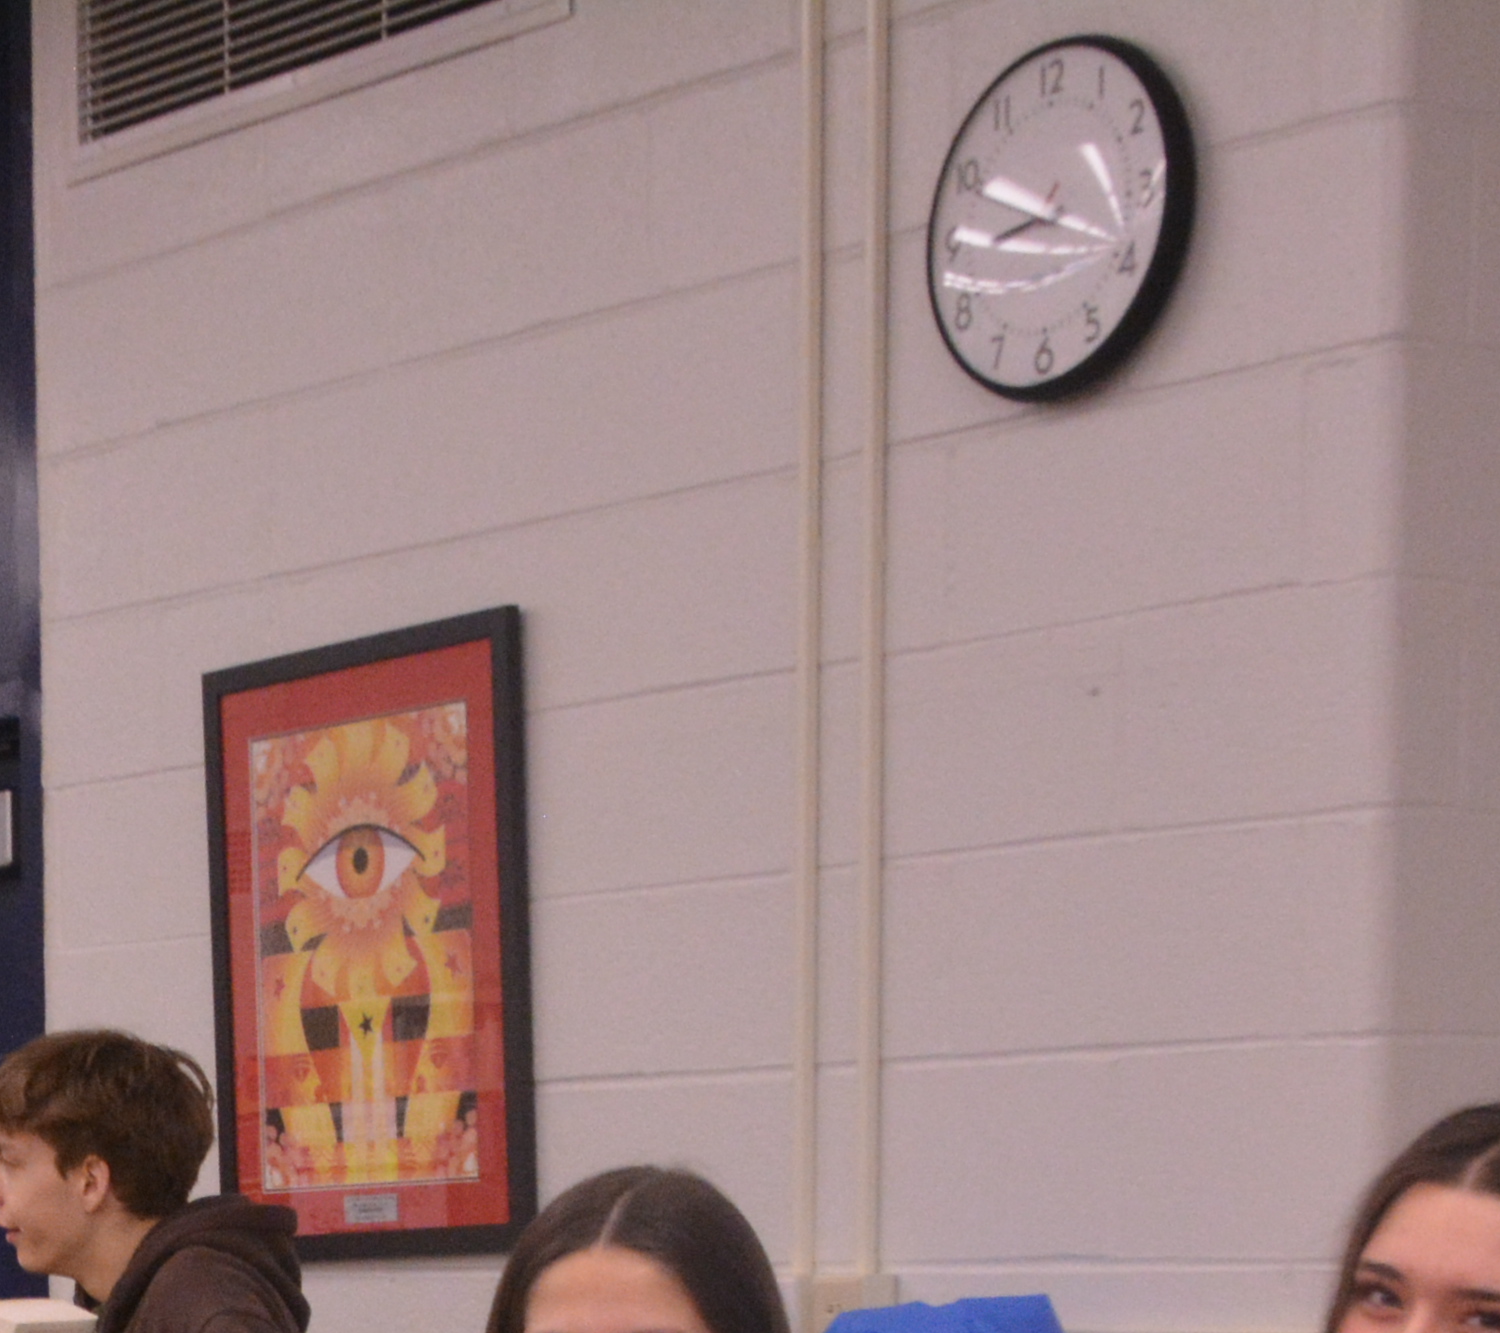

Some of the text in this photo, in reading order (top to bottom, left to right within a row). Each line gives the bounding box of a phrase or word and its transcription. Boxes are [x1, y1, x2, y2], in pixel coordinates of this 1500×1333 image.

[1039, 59, 1064, 95] 12
[1097, 67, 1105, 98] 1
[993, 102, 1013, 135] 11
[1129, 100, 1145, 135] 2
[956, 160, 982, 196] 10
[1117, 241, 1136, 274] 4
[955, 295, 972, 331] 8
[1085, 305, 1100, 343] 5
[991, 336, 1005, 368] 7
[1035, 337, 1054, 374] 6
